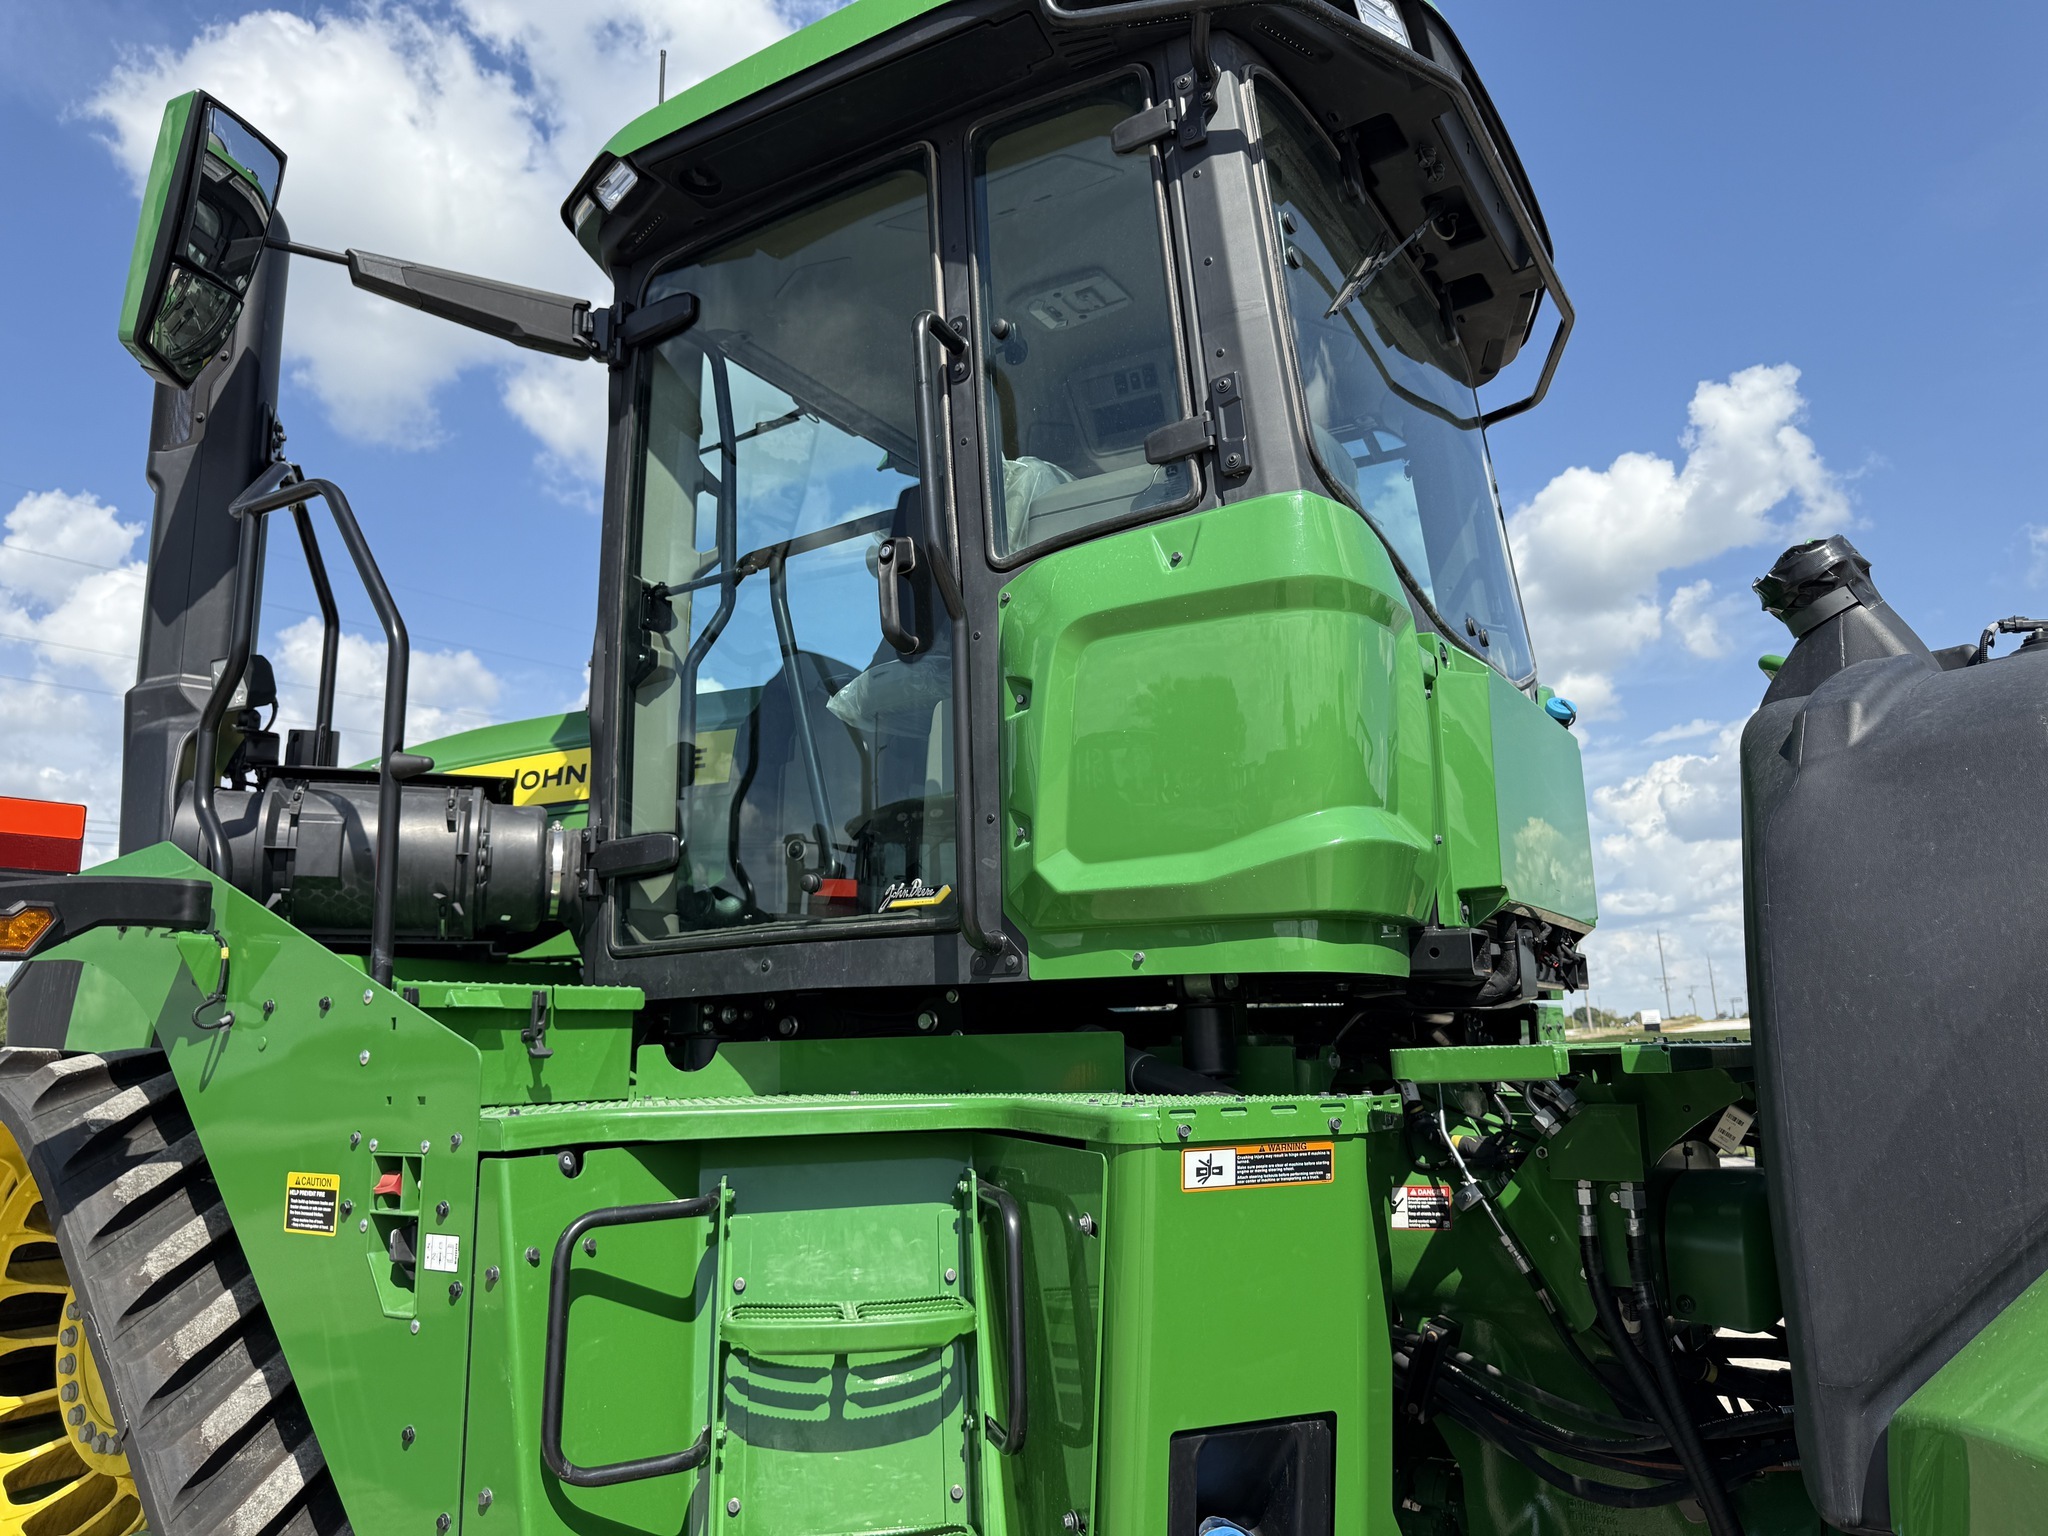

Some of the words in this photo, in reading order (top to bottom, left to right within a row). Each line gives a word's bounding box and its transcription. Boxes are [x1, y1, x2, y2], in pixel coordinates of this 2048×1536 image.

[878, 883, 909, 913] John
[909, 878, 934, 897] Deere
[1268, 1143, 1306, 1151] WARNING
[302, 1177, 332, 1187] CAUTION
